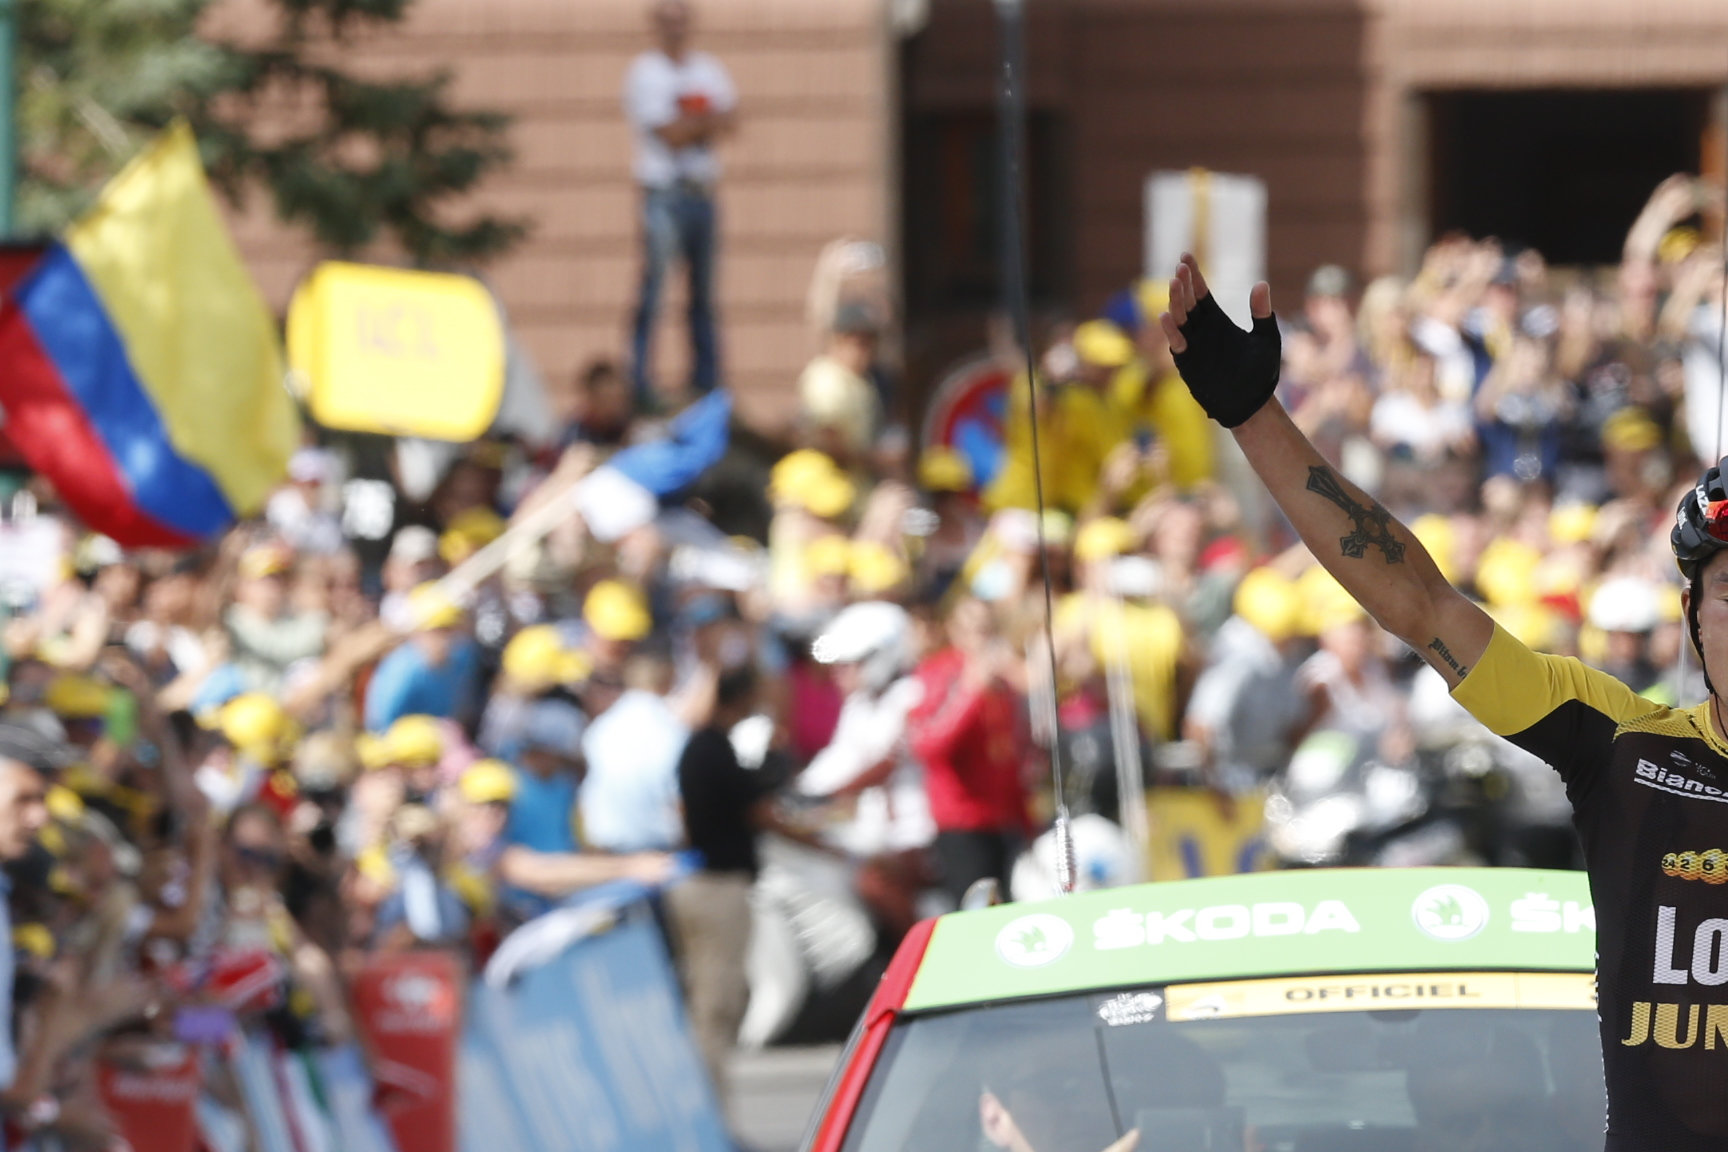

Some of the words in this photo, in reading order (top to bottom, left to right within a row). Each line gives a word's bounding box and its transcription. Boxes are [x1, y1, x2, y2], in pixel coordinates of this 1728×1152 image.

[1702, 858, 1714, 872] 6
[1092, 900, 1361, 951] ŠKODA
[1285, 983, 1480, 1002] OFFICIEL
